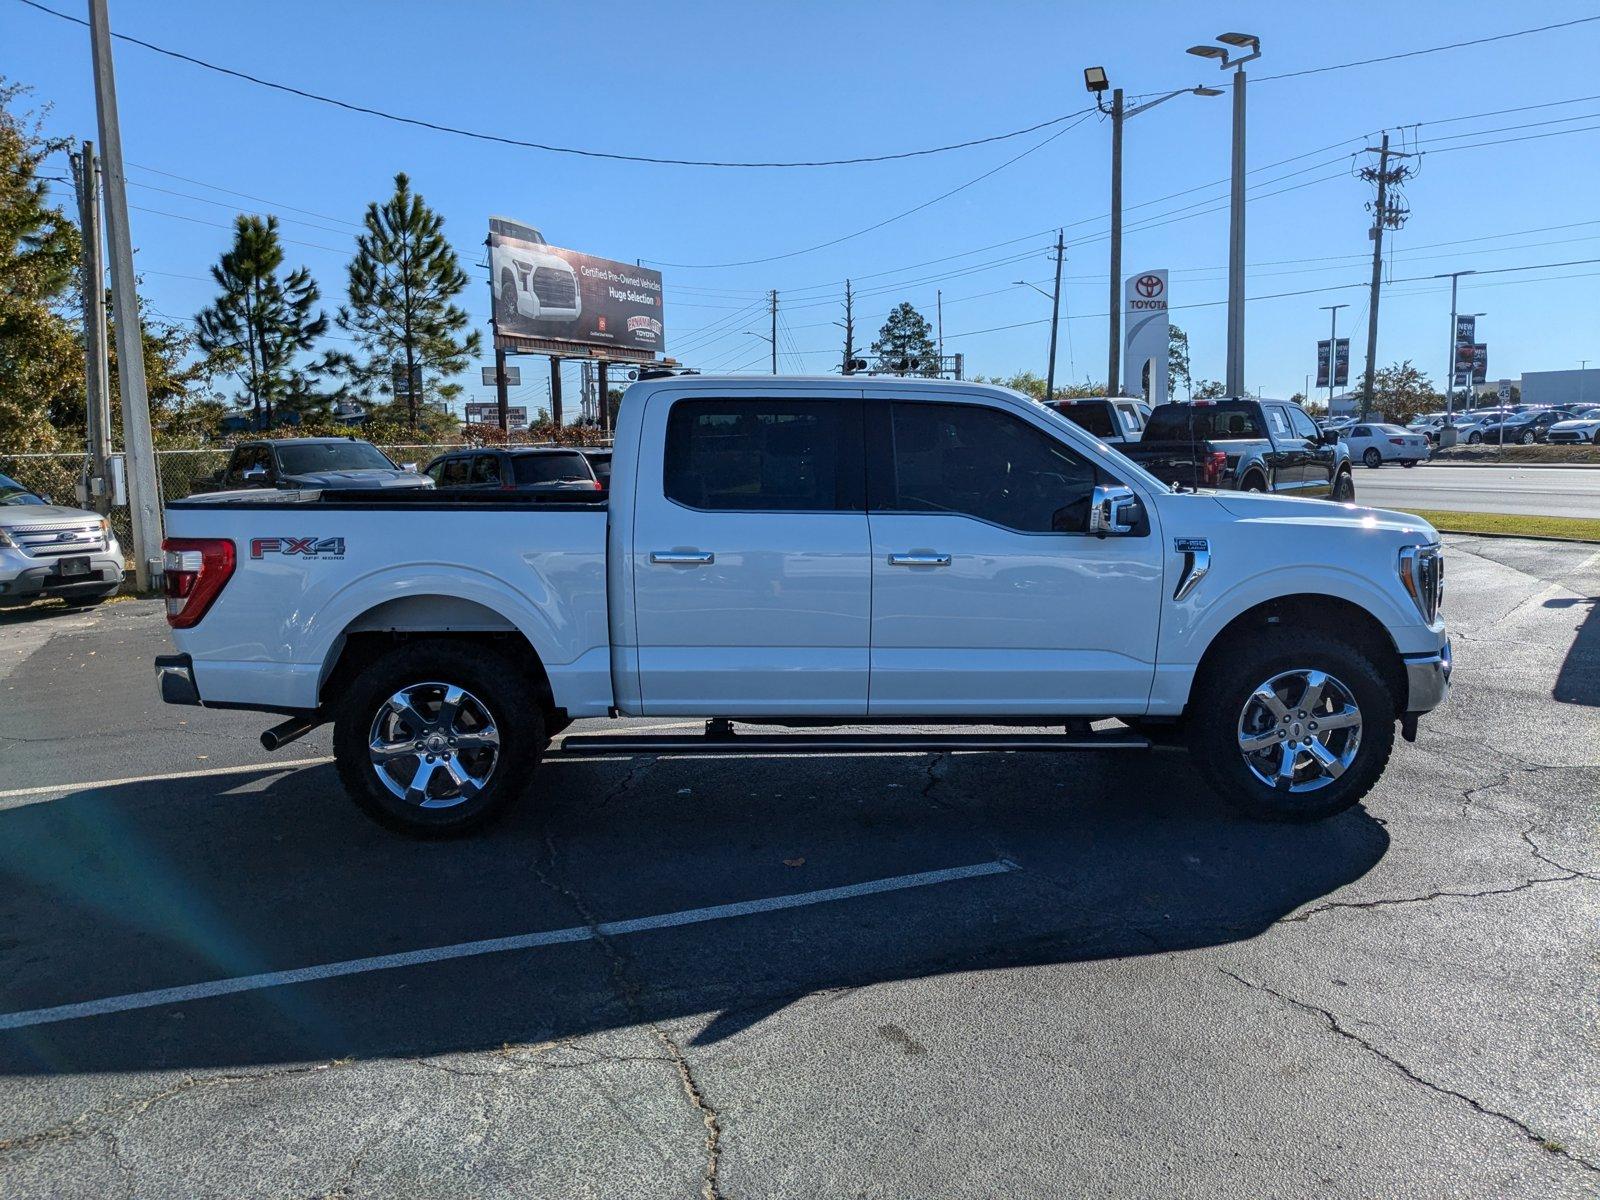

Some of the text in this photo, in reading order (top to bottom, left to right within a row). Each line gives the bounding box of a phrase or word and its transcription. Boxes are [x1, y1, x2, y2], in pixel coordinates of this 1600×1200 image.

[581, 265, 661, 291] Certified Pre-Owned Vehicles
[609, 286, 654, 305] Huge Selection
[1130, 300, 1168, 309] TOYOTA
[636, 330, 656, 339] TOYOTA
[1499, 389, 1510, 398] 45
[250, 537, 345, 560] FX4
